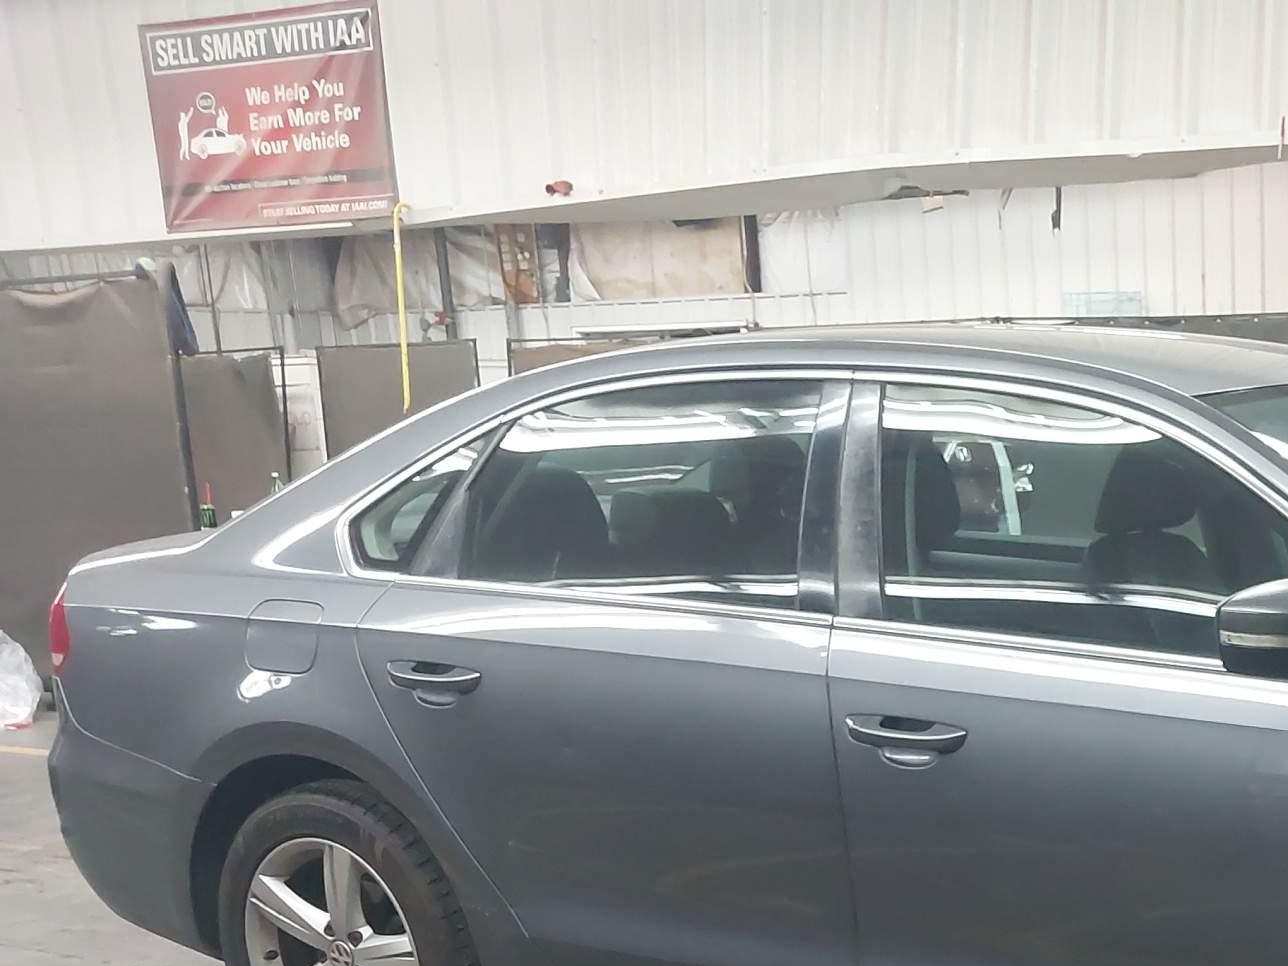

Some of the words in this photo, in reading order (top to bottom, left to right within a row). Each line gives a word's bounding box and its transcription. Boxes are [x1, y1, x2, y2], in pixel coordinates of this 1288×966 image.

[155, 37, 199, 68] SELL
[201, 28, 267, 62] SMART
[269, 22, 326, 55] WITH
[328, 16, 366, 51] IAA
[246, 86, 270, 106] We
[274, 82, 309, 105] Help
[312, 79, 344, 99] You
[249, 112, 283, 132] Earn
[287, 107, 329, 127] More
[334, 103, 361, 122] For
[252, 137, 289, 156] Your
[293, 131, 350, 153] Vehicle
[316, 203, 340, 215] TODAY
